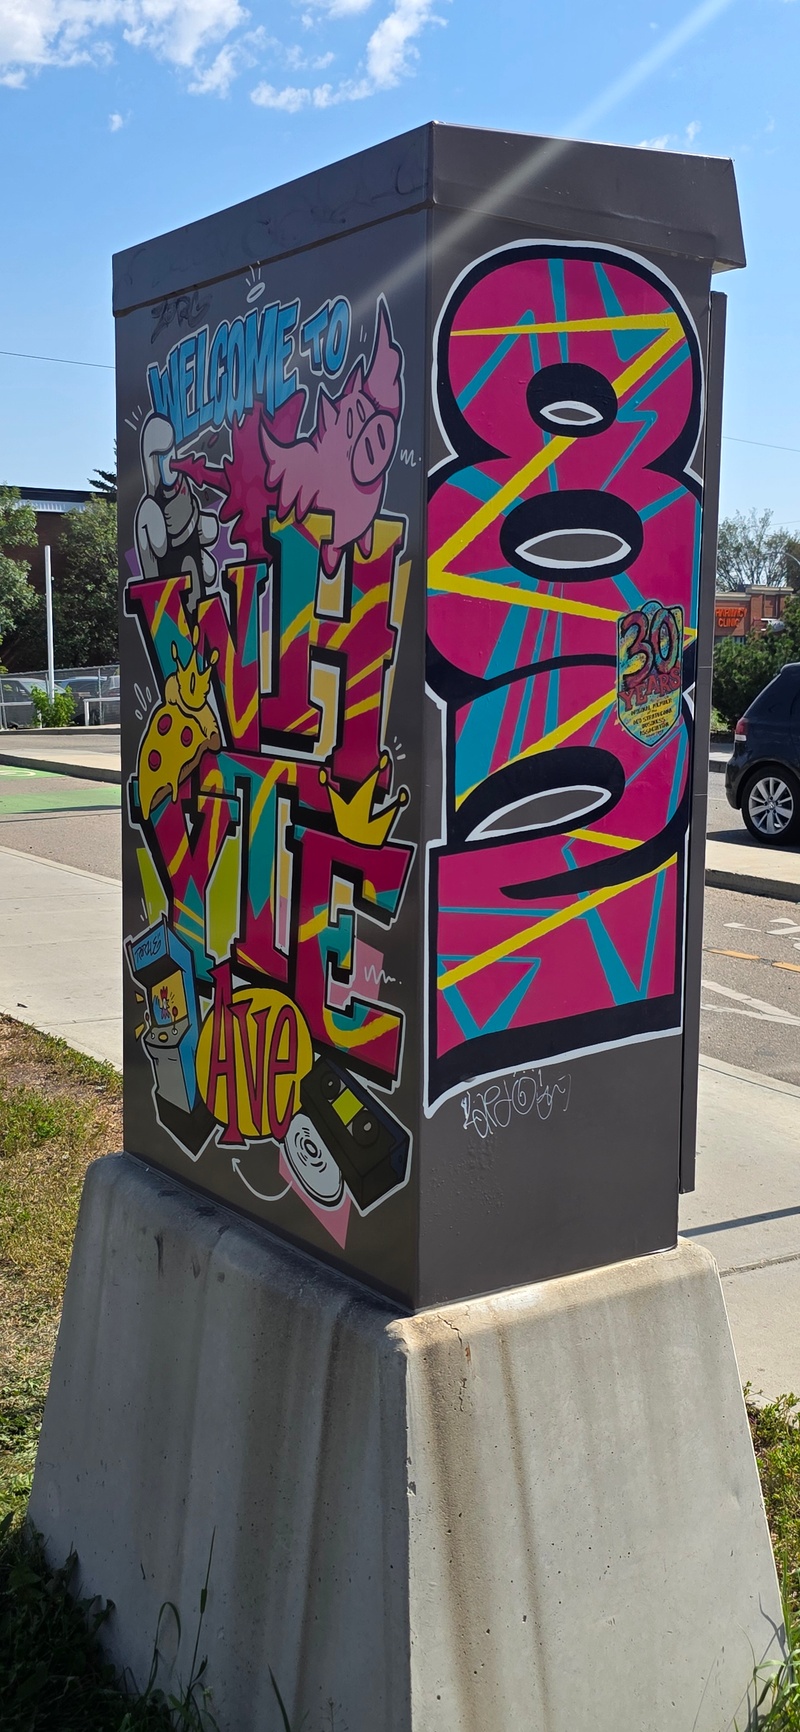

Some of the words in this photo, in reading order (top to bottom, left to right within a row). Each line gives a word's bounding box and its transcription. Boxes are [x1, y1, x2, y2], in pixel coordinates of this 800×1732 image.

[148, 299, 300, 446] WELCOME
[301, 297, 351, 374] TO
[620, 608, 680, 689] 30
[718, 618, 740, 627] CLINIC
[617, 659, 681, 711] YEARS
[206, 962, 299, 1145] Ave
